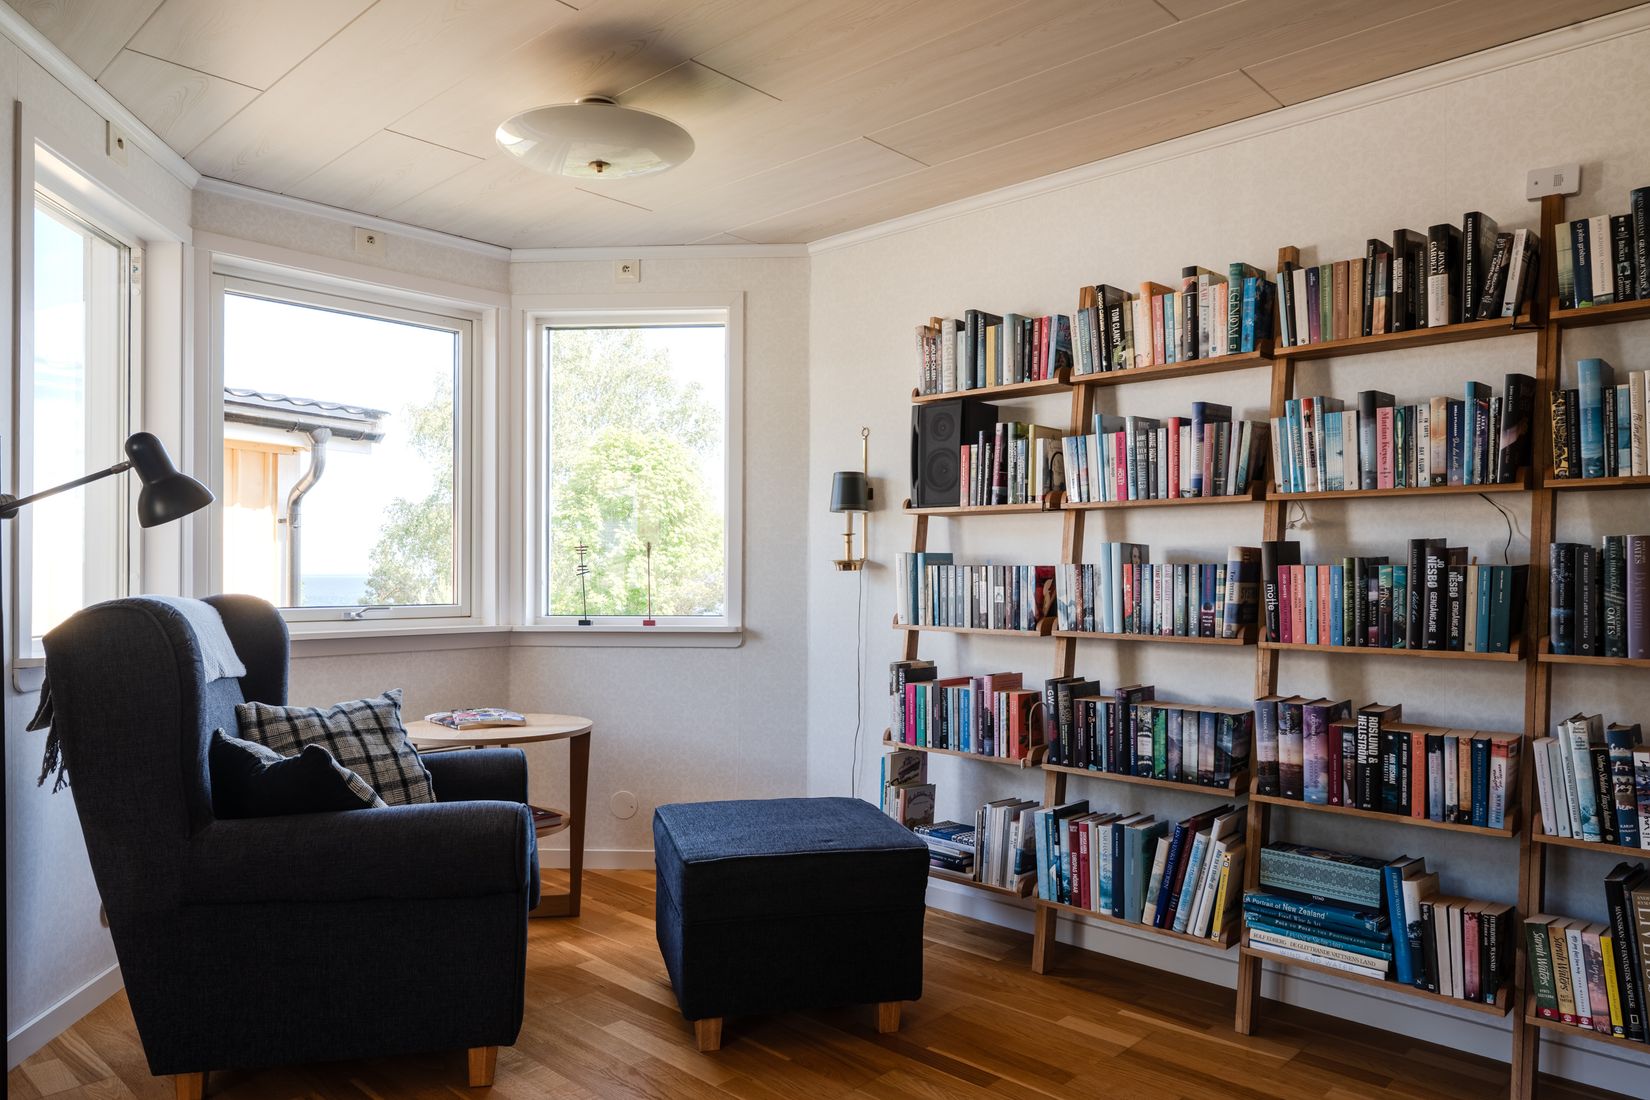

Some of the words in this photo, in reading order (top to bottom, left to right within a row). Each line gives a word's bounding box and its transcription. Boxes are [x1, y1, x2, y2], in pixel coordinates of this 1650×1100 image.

[1577, 228, 1585, 242] john
[1576, 242, 1586, 266] grisham
[1639, 255, 1647, 289] MOUNTAIN
[1617, 276, 1625, 301] GRISHAM
[1112, 308, 1120, 322] TOM
[1229, 288, 1240, 338] EGENDOM
[1112, 323, 1120, 346] CLANCY
[1292, 425, 1302, 467] ANALFABETEN
[1380, 442, 1389, 465] Keyes
[1427, 556, 1438, 588] NESBØ
[1438, 559, 1445, 568] JO
[1449, 572, 1458, 597] NESBØ
[1266, 584, 1278, 611] motte
[1429, 592, 1439, 632] GENGÅNGARE
[1451, 601, 1460, 637] GENGÅNGARE
[1607, 607, 1616, 635] OATES
[1048, 690, 1054, 704] GW
[1358, 715, 1368, 764] HELLSTRÖM
[1369, 717, 1378, 755] ROSLUND
[1596, 754, 1605, 771] Sidney
[1598, 773, 1610, 793] Sheldon
[1170, 836, 1178, 862] SVENSKA
[1192, 840, 1202, 862] Svenskt
[1164, 862, 1173, 889] HISTORIEN
[1252, 898, 1273, 908] Portrait
[1282, 904, 1296, 913] New
[1298, 906, 1325, 919] Zealand
[1298, 943, 1330, 955] GLITTRANDE
[1360, 958, 1376, 967] LAND
[1533, 932, 1548, 957] Sarah
[1553, 936, 1567, 961] Sarah
[1304, 954, 1322, 965] AND
[1325, 959, 1354, 971] WATER
[1536, 958, 1550, 986] Waters
[1621, 947, 1632, 982] FANTASTISK
[1557, 962, 1570, 992] Waters
[1626, 983, 1635, 1008] SKAPELSE
